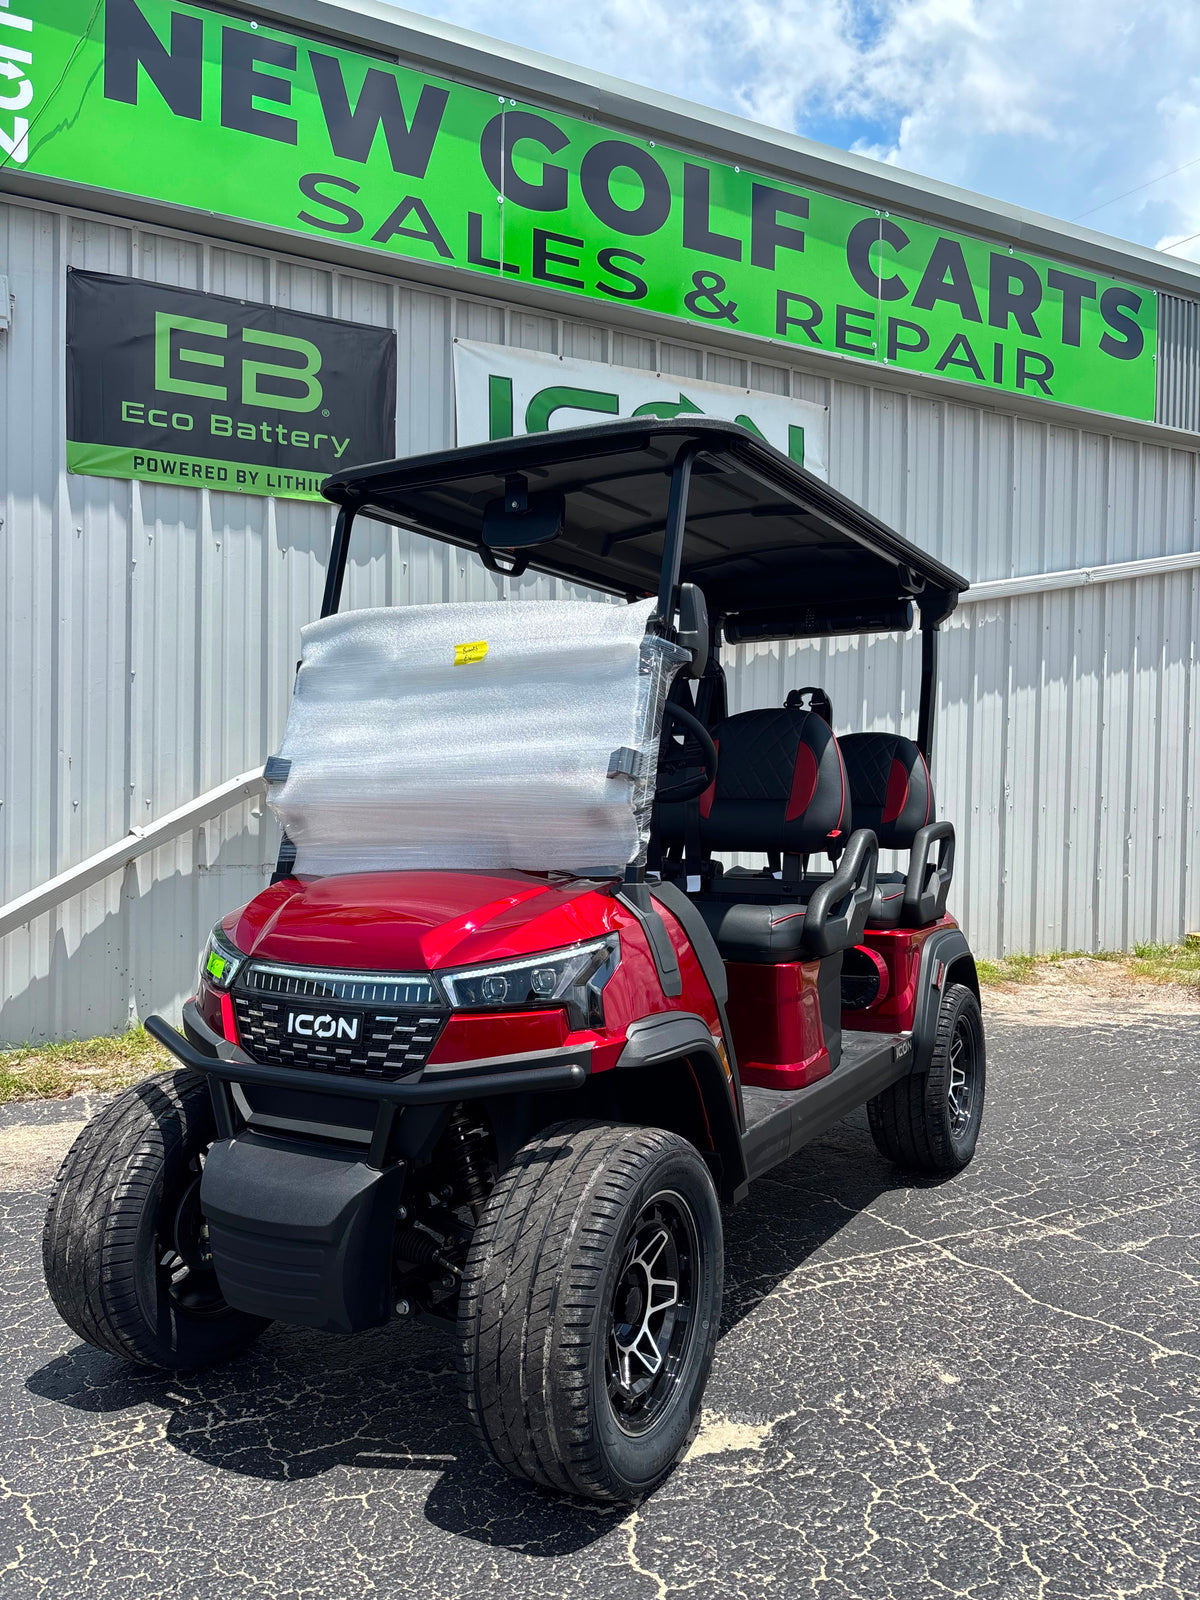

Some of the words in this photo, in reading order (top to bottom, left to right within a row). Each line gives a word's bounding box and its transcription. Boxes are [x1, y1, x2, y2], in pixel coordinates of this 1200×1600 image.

[104, 0, 450, 179] NEW
[480, 110, 810, 271] GOLF
[846, 217, 1144, 360] CARTS
[297, 172, 649, 301] SALES
[684, 270, 740, 324] &
[775, 289, 1055, 395] REPAIR
[155, 311, 323, 413] EB
[121, 400, 194, 431] Eco
[210, 413, 351, 458] Battery
[133, 455, 228, 482] POWERED
[236, 469, 259, 486] BY
[287, 1012, 358, 1040] ICON
